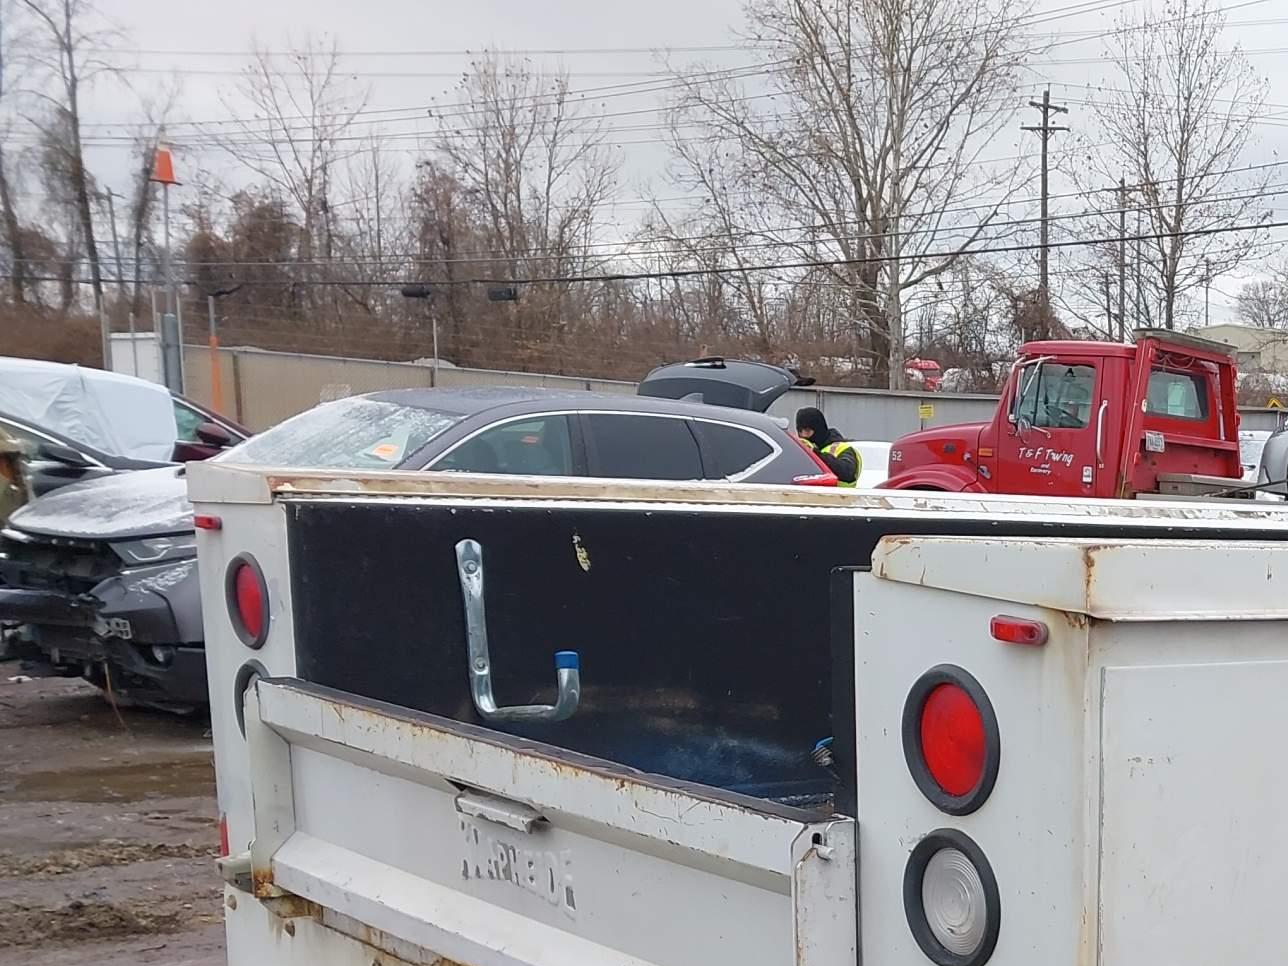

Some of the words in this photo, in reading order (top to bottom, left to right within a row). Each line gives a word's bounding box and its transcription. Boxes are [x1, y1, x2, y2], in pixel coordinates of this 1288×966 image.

[891, 450, 903, 462] 52
[1018, 447, 1027, 460] T
[1025, 448, 1034, 458] &
[1034, 446, 1044, 460] F
